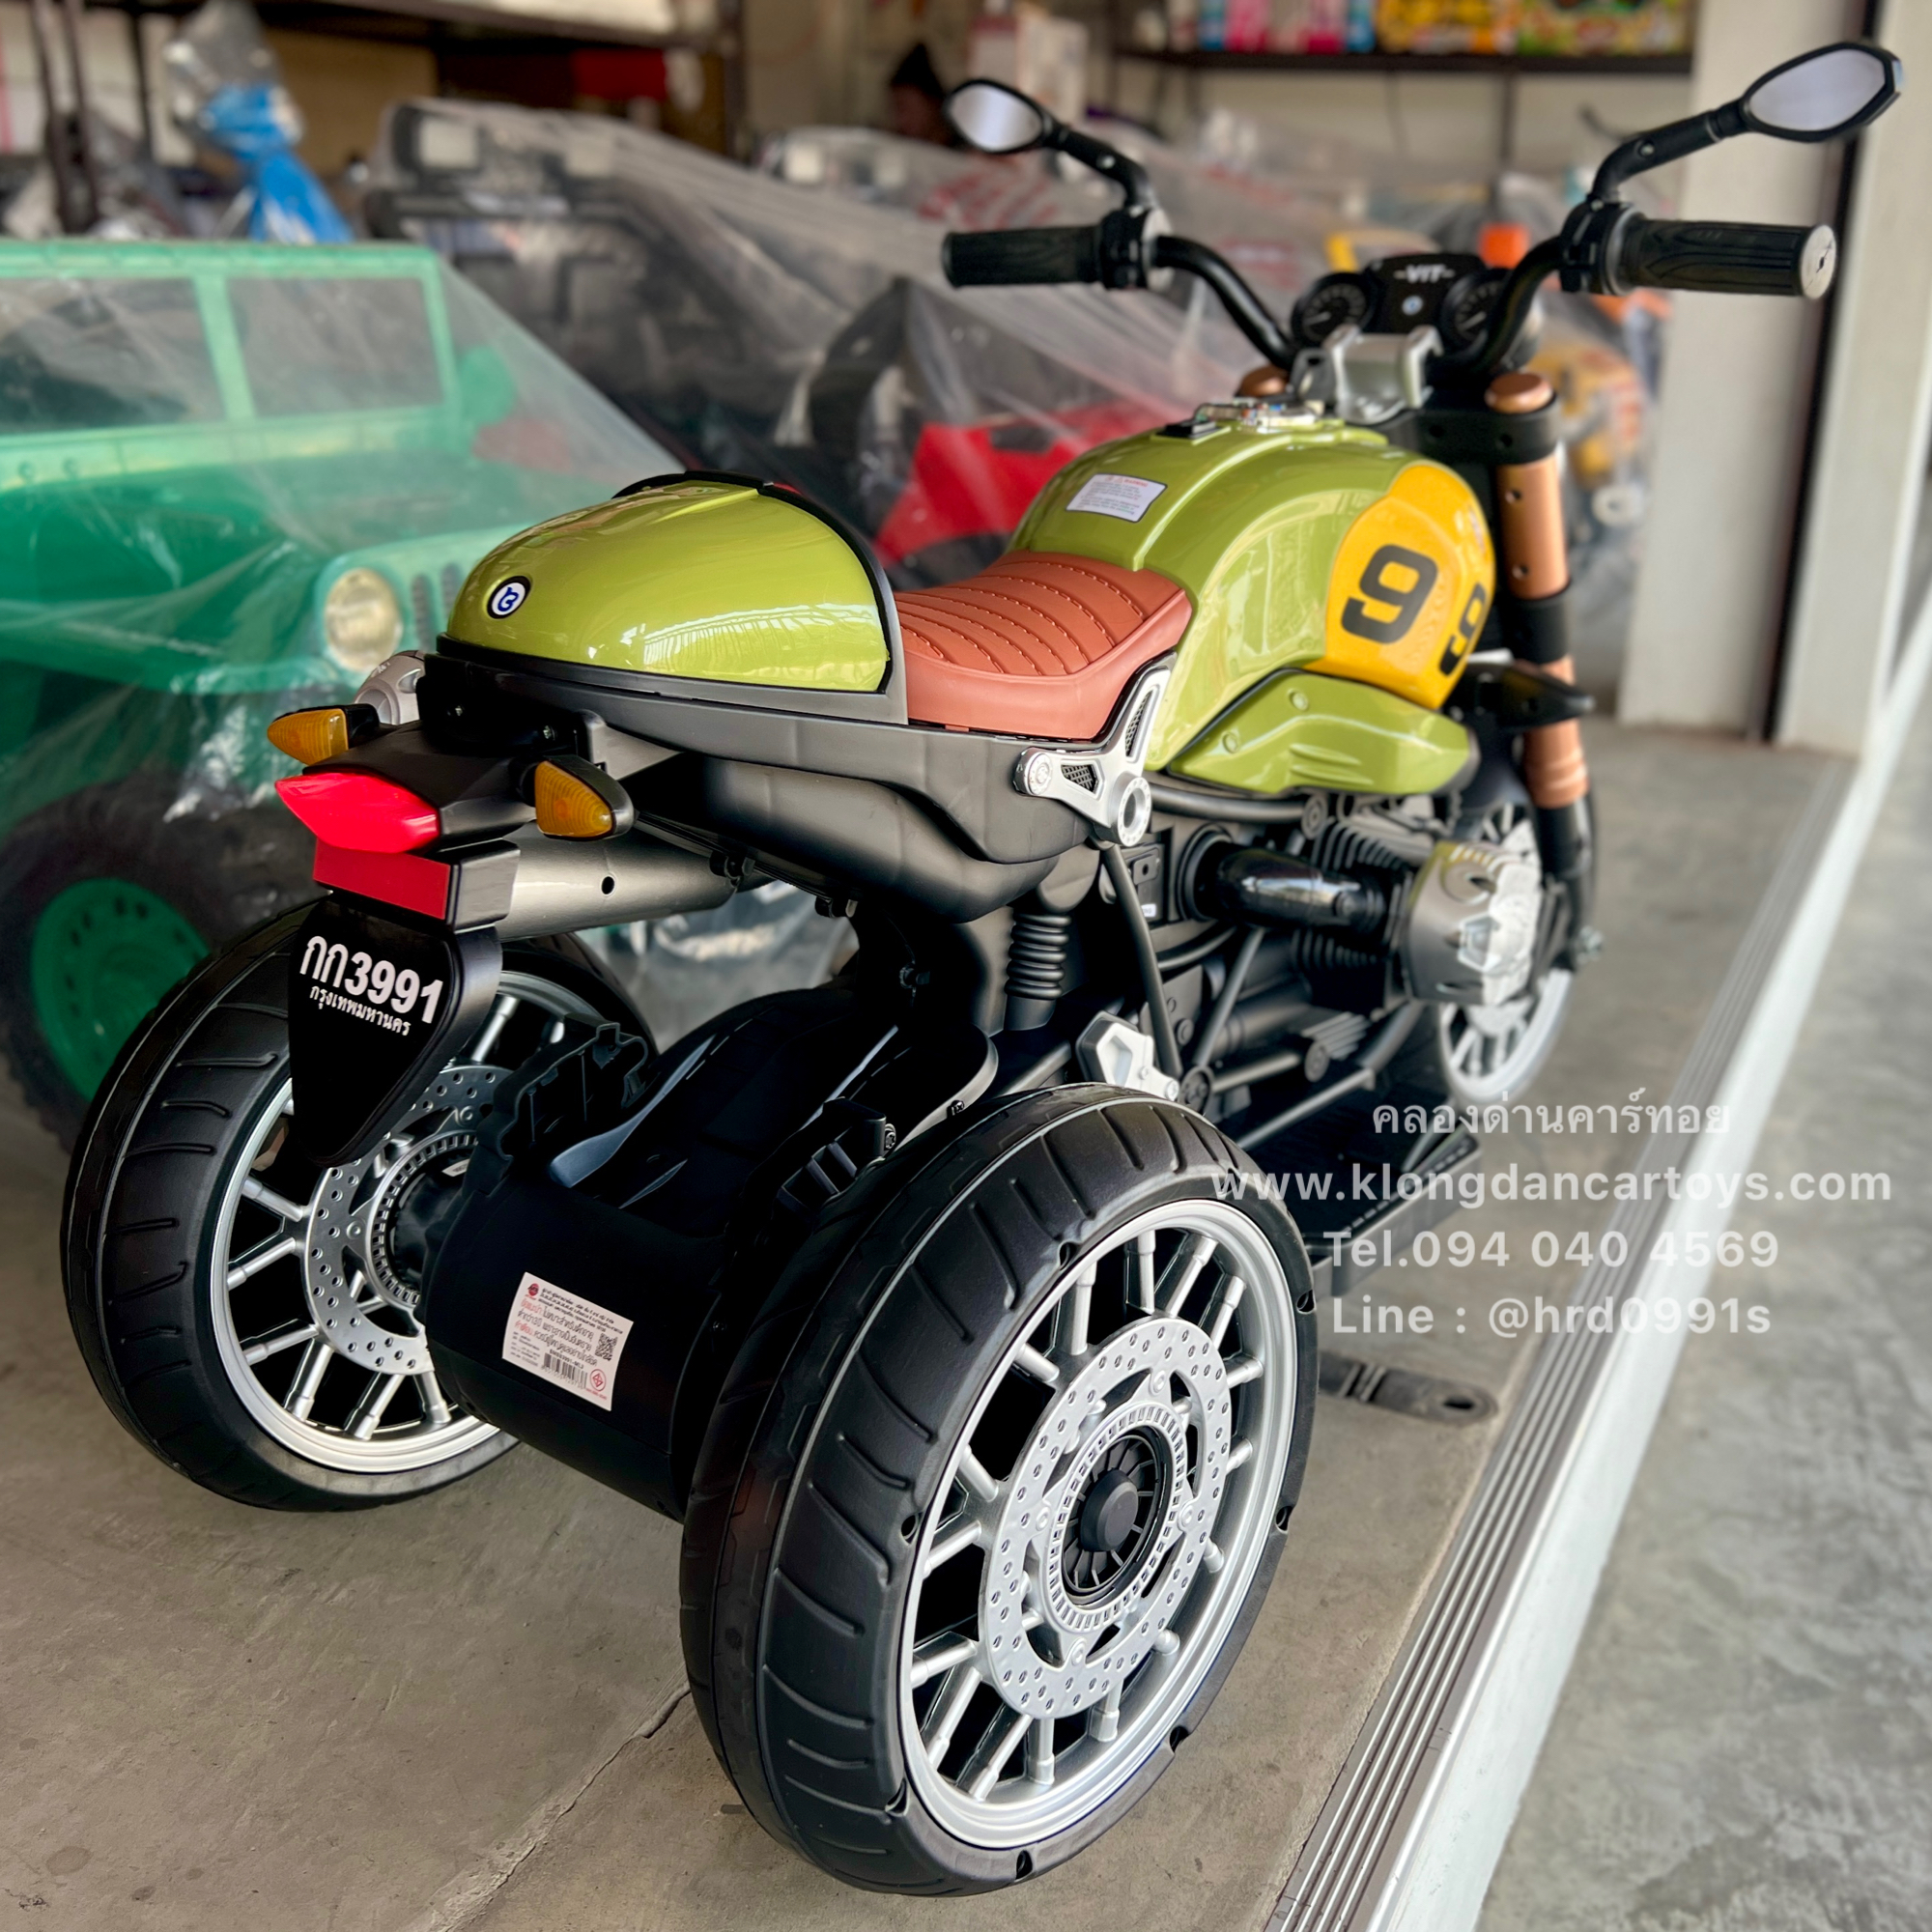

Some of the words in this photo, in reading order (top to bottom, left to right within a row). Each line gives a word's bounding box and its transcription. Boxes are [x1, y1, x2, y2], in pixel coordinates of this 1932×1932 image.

[299, 935, 443, 1024] กก3991
[309, 985, 412, 1037] กรุงเทพมหานคร
